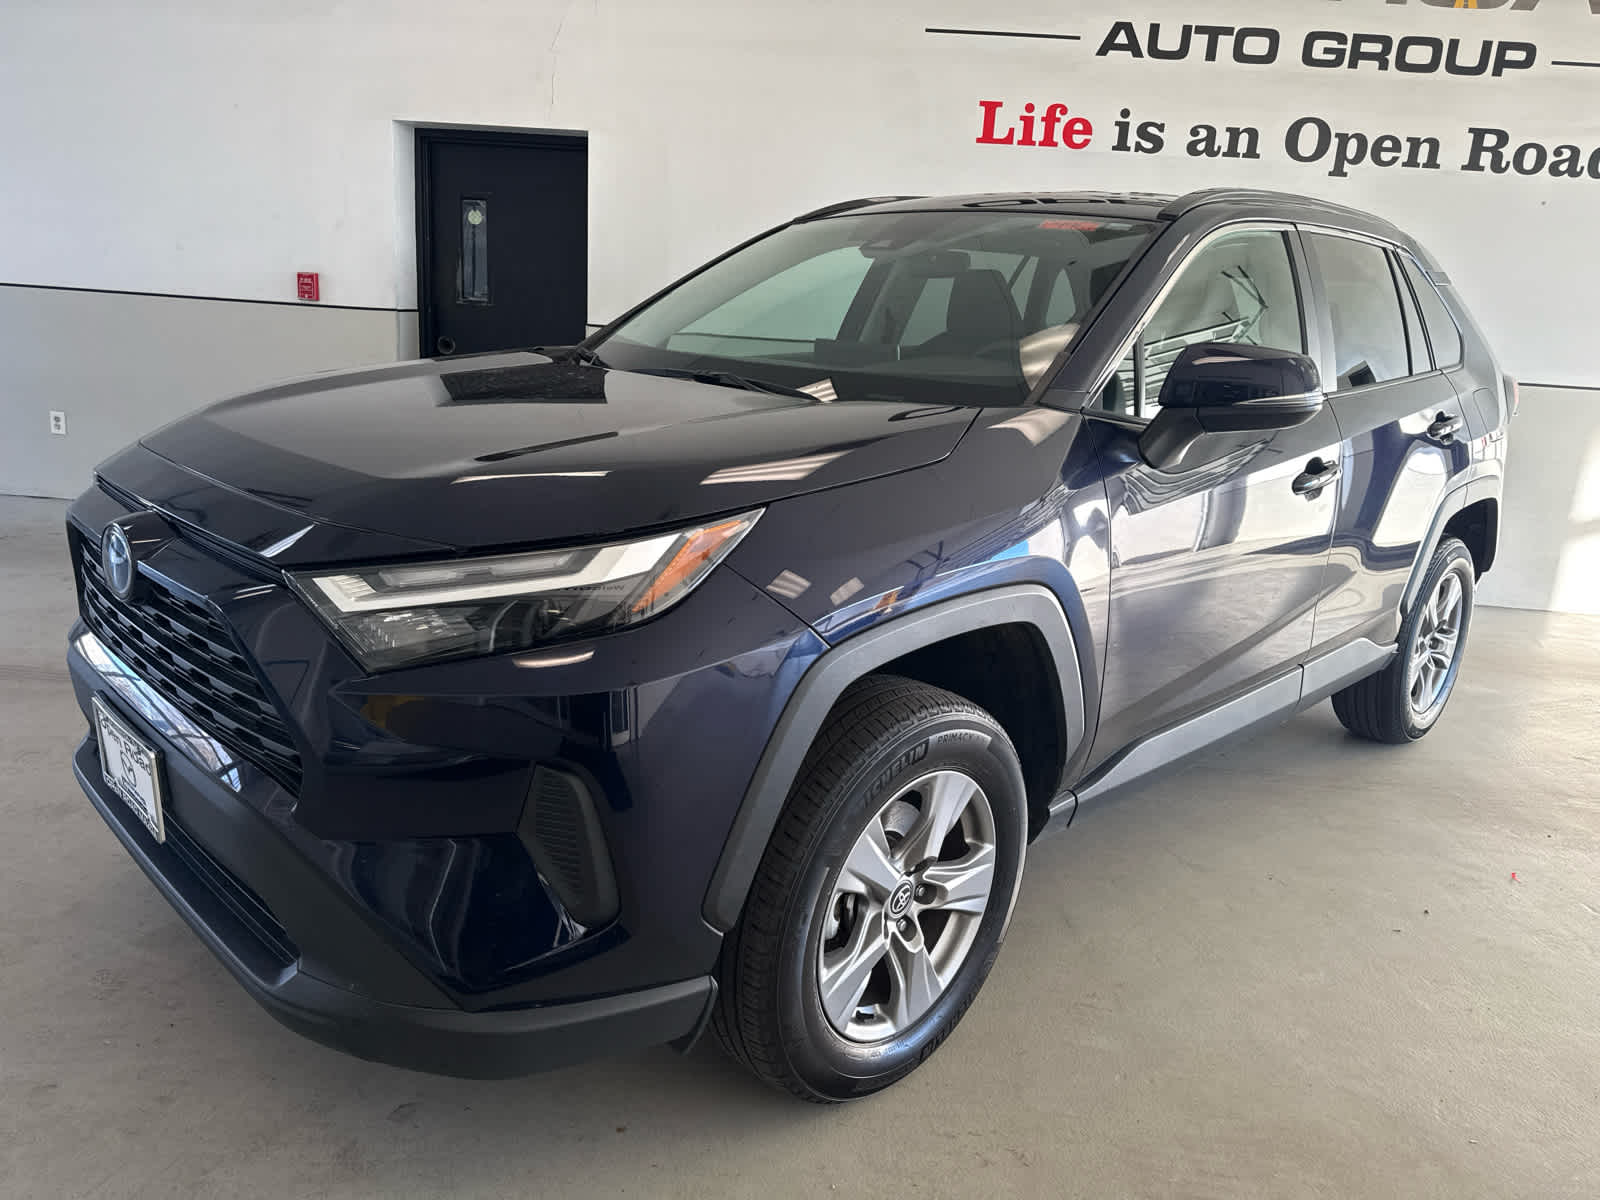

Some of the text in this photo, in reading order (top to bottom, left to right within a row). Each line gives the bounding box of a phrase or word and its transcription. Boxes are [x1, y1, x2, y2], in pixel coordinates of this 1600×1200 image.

[1096, 22, 1536, 77] AUTO GROUP
[976, 101, 1093, 149] Life
[1112, 108, 1165, 154] is
[1186, 125, 1260, 159] an
[1285, 117, 1440, 177] Open
